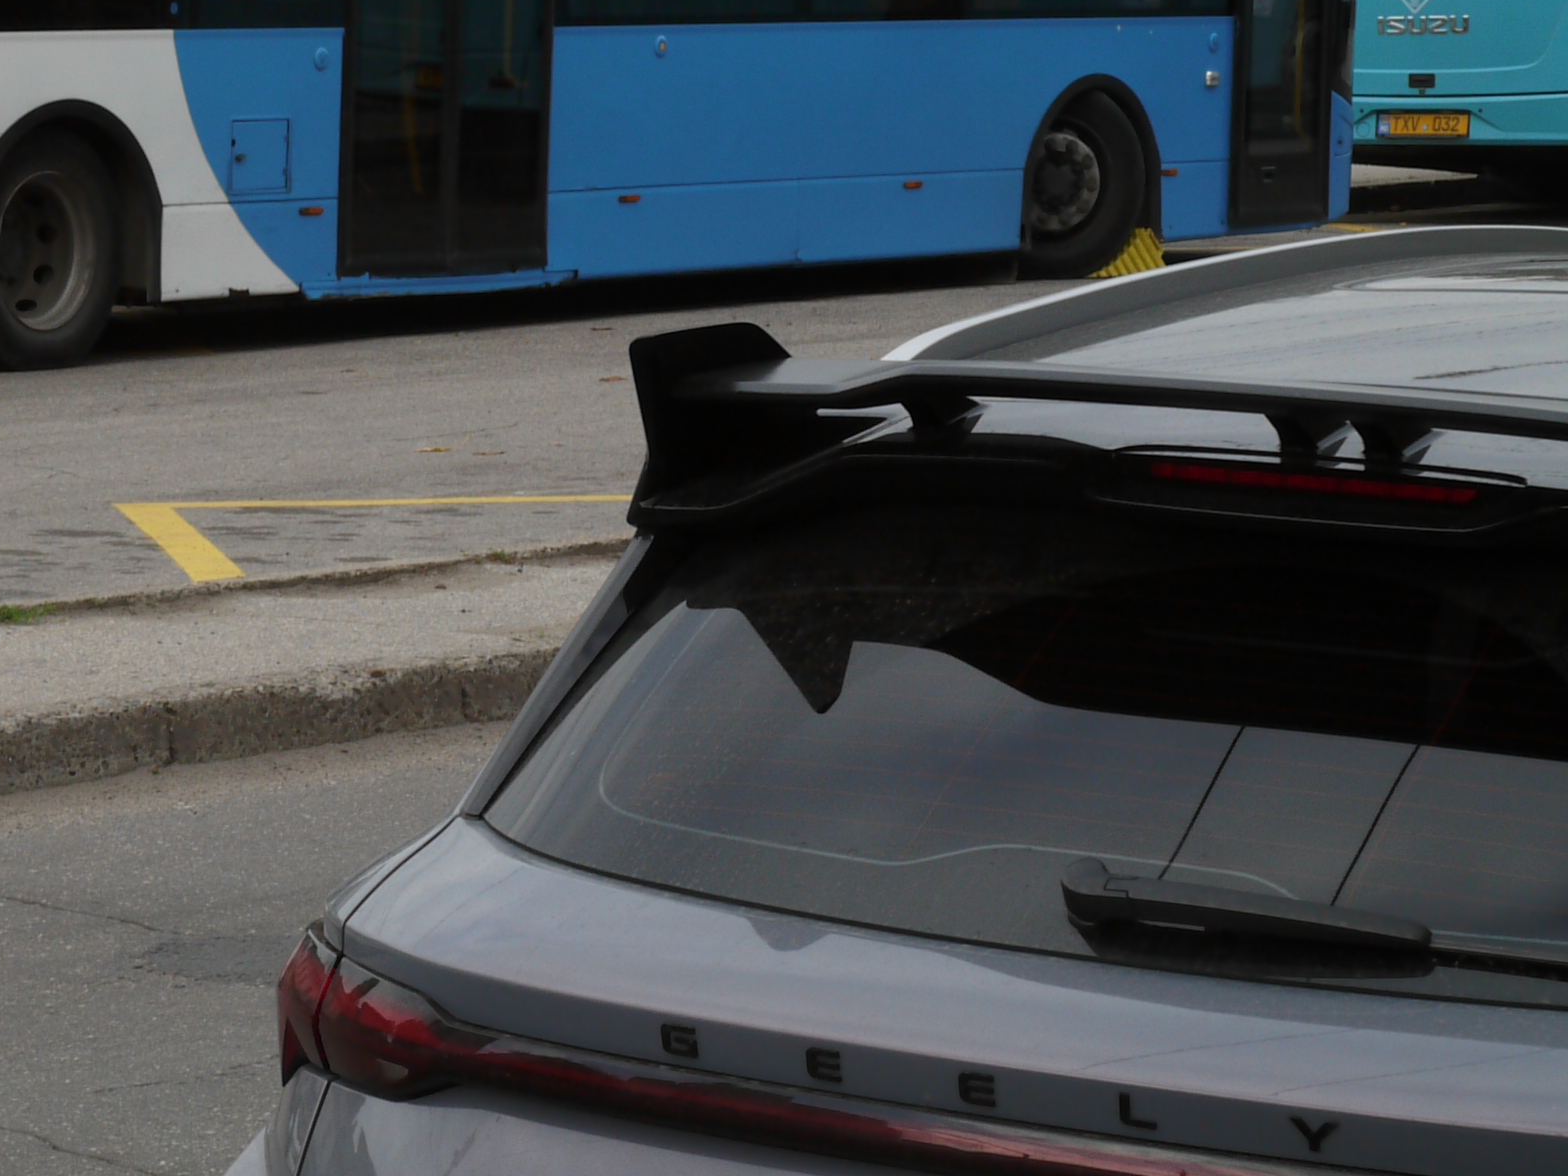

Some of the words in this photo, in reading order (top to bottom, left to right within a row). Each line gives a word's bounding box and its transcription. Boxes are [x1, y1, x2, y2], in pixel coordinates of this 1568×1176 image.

[1377, 14, 1470, 36] ISUZU
[1392, 116, 1421, 133] TXV
[1432, 115, 1460, 133] 032
[660, 1023, 1338, 1154] GEELY
